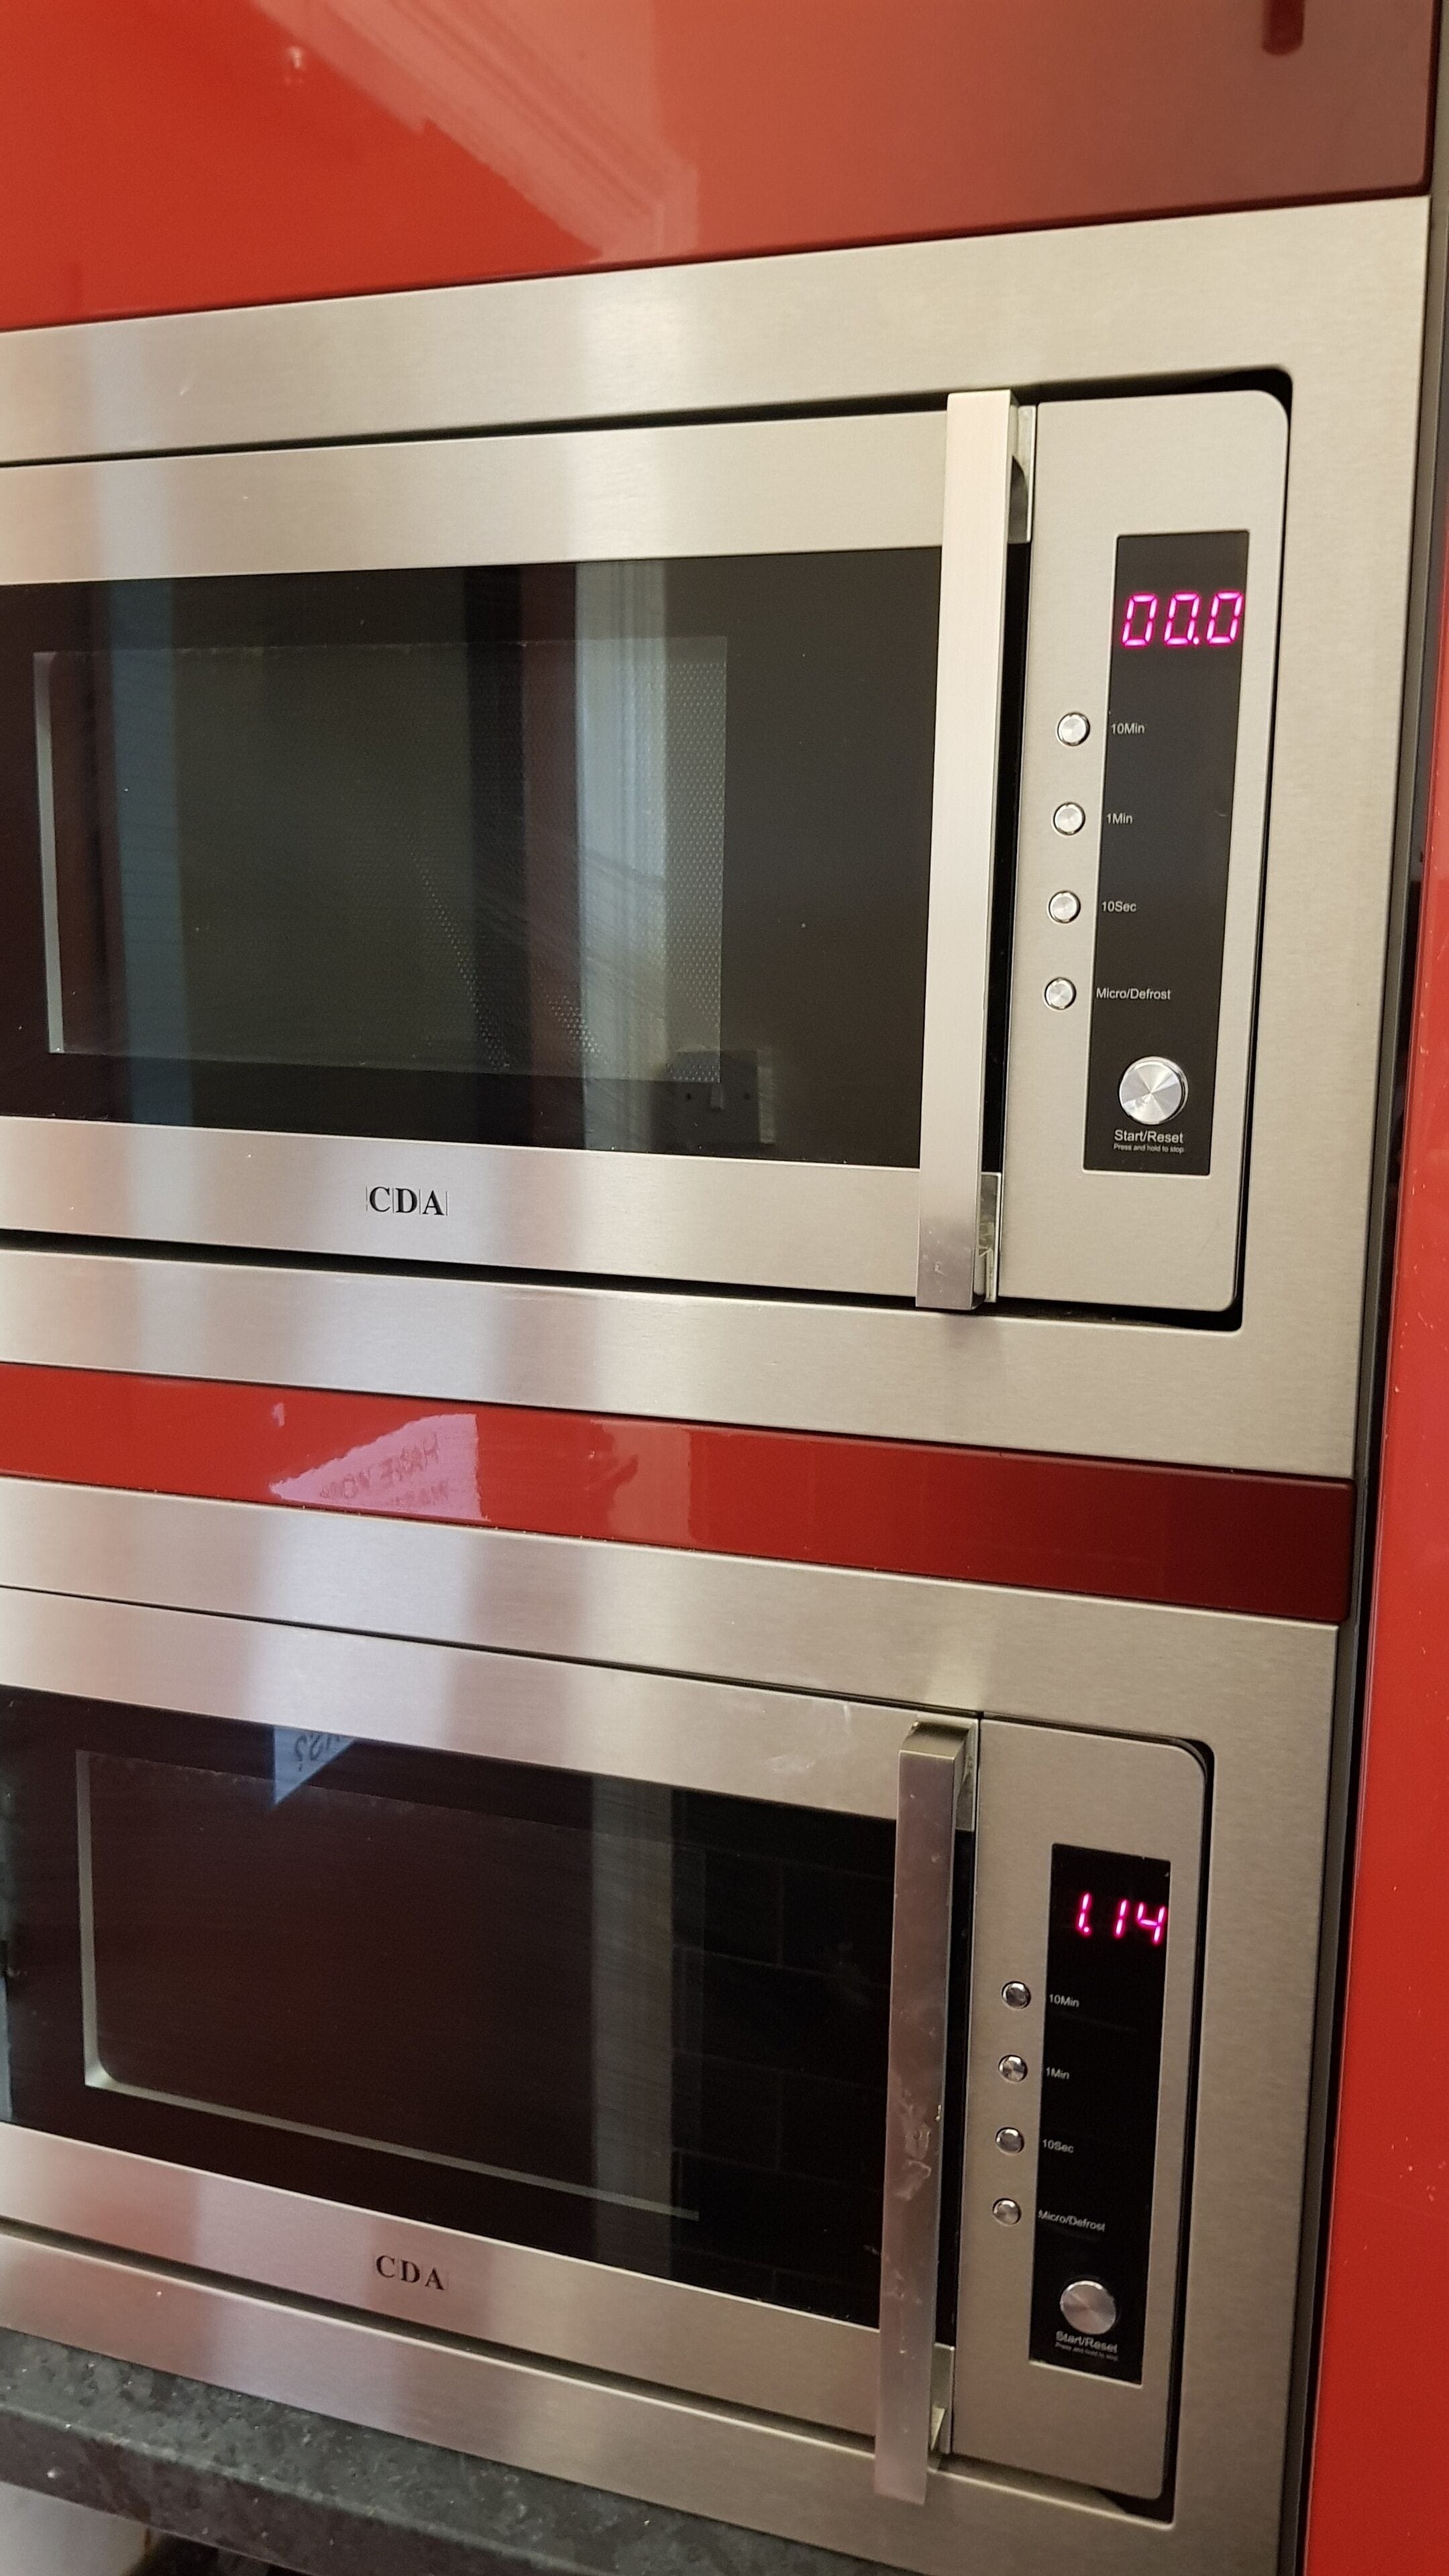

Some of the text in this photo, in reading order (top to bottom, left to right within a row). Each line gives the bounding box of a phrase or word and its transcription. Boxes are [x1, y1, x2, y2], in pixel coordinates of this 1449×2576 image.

[1121, 591, 1244, 646] 00.0
[1110, 721, 1145, 735] 10Min
[1106, 812, 1133, 824] 1Min
[1101, 900, 1137, 912] 10Sec
[1095, 987, 1171, 1001] Micro/Defrost
[1114, 1128, 1184, 1144] Start/Reset
[1169, 1146, 1185, 1154] stop
[369, 1185, 445, 1216] CDA
[1076, 1891, 1166, 1943] 1.14
[1049, 1993, 1080, 2008] 10Min
[1045, 2066, 1070, 2080] 1Min
[1042, 2139, 1075, 2153] 10Sec
[1038, 2208, 1106, 2233] Micro/Defrost
[375, 2255, 445, 2291] CDA
